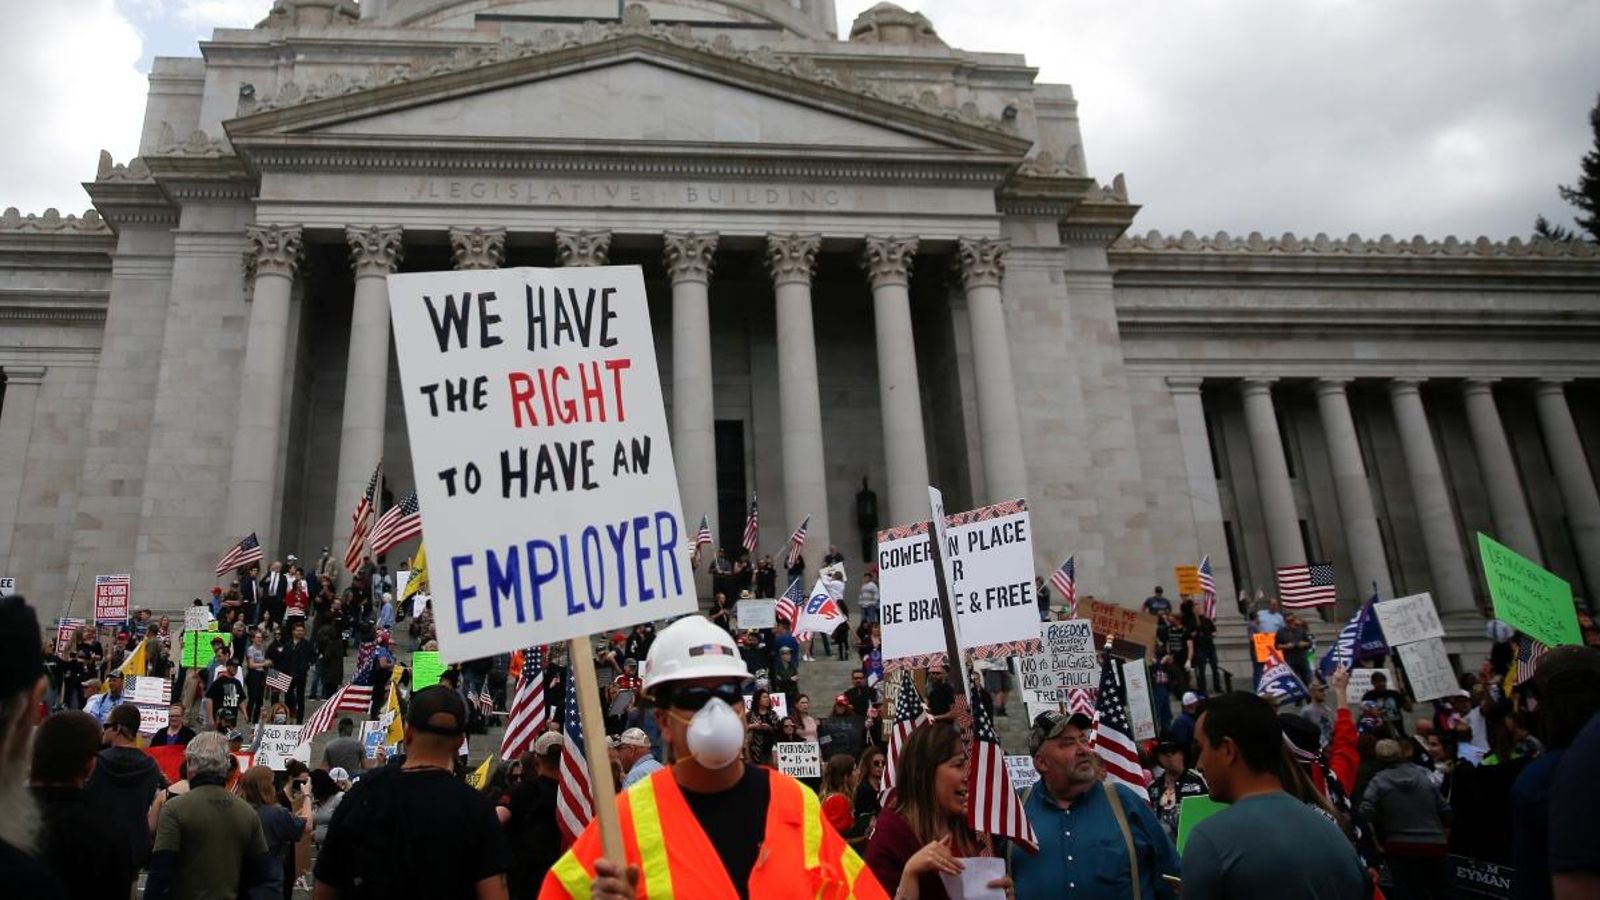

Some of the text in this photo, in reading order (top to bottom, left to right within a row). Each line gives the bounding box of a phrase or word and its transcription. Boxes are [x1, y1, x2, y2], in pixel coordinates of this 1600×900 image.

[428, 182, 840, 206] LEGISLATIVE BUILDING
[423, 284, 618, 353] WE HAVE
[420, 358, 632, 428] THE RIGHT
[438, 435, 651, 499] TO HAVE AN
[947, 534, 959, 557] N
[967, 520, 1026, 552] PLACE
[451, 510, 683, 634] EMPLOYER
[952, 560, 964, 581] R
[882, 582, 1033, 625] BE BRAE & FREE
[1093, 613, 1133, 634] LIBERTY
[1122, 609, 1137, 622] ME
[1048, 623, 1090, 639] FREEDOM
[1021, 657, 1037, 674] NO
[1024, 673, 1039, 689] NO
[1056, 670, 1092, 687] FAUCI
[780, 744, 816, 754] EVERYBODY
[795, 755, 802, 765] IS
[1456, 866, 1511, 889] EYMAN
